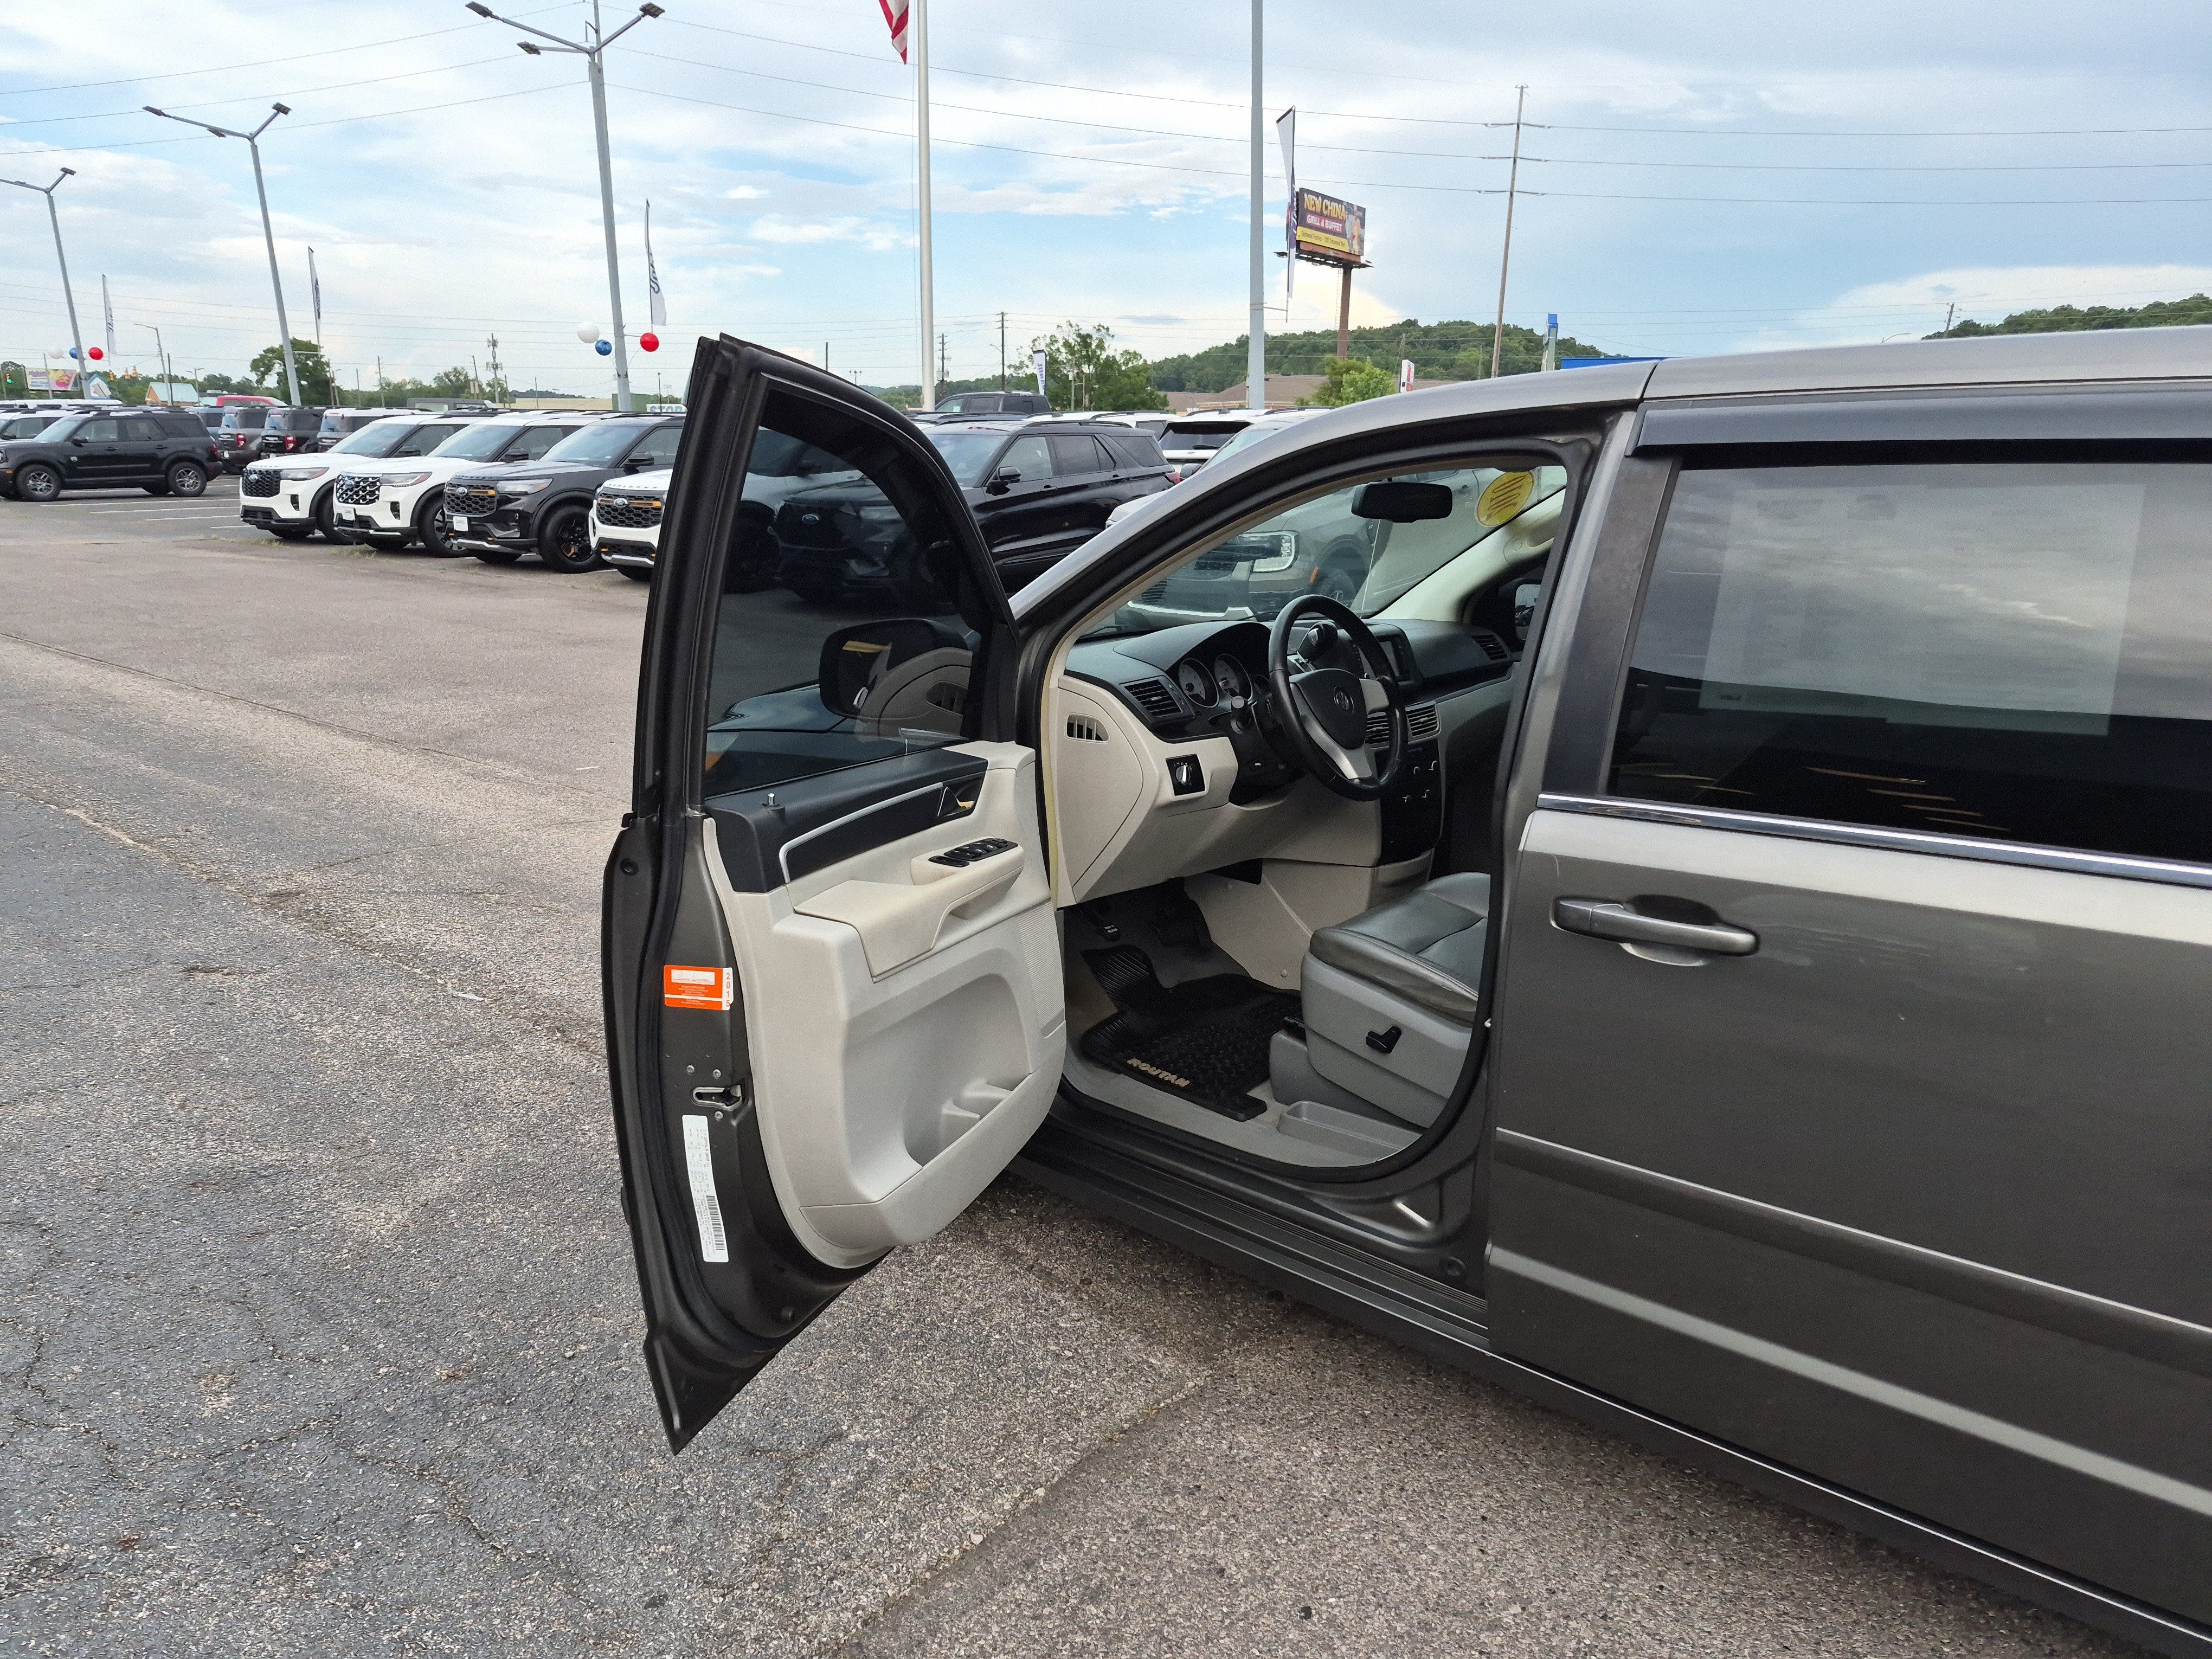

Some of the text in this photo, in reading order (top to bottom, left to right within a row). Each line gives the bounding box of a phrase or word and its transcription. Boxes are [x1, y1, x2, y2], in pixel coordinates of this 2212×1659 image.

[1304, 193, 1346, 220] NEW CHINA
[1307, 214, 1320, 226] GRILL
[1325, 220, 1342, 232] BUFFET
[1127, 1058, 1191, 1087] ROUTAN
